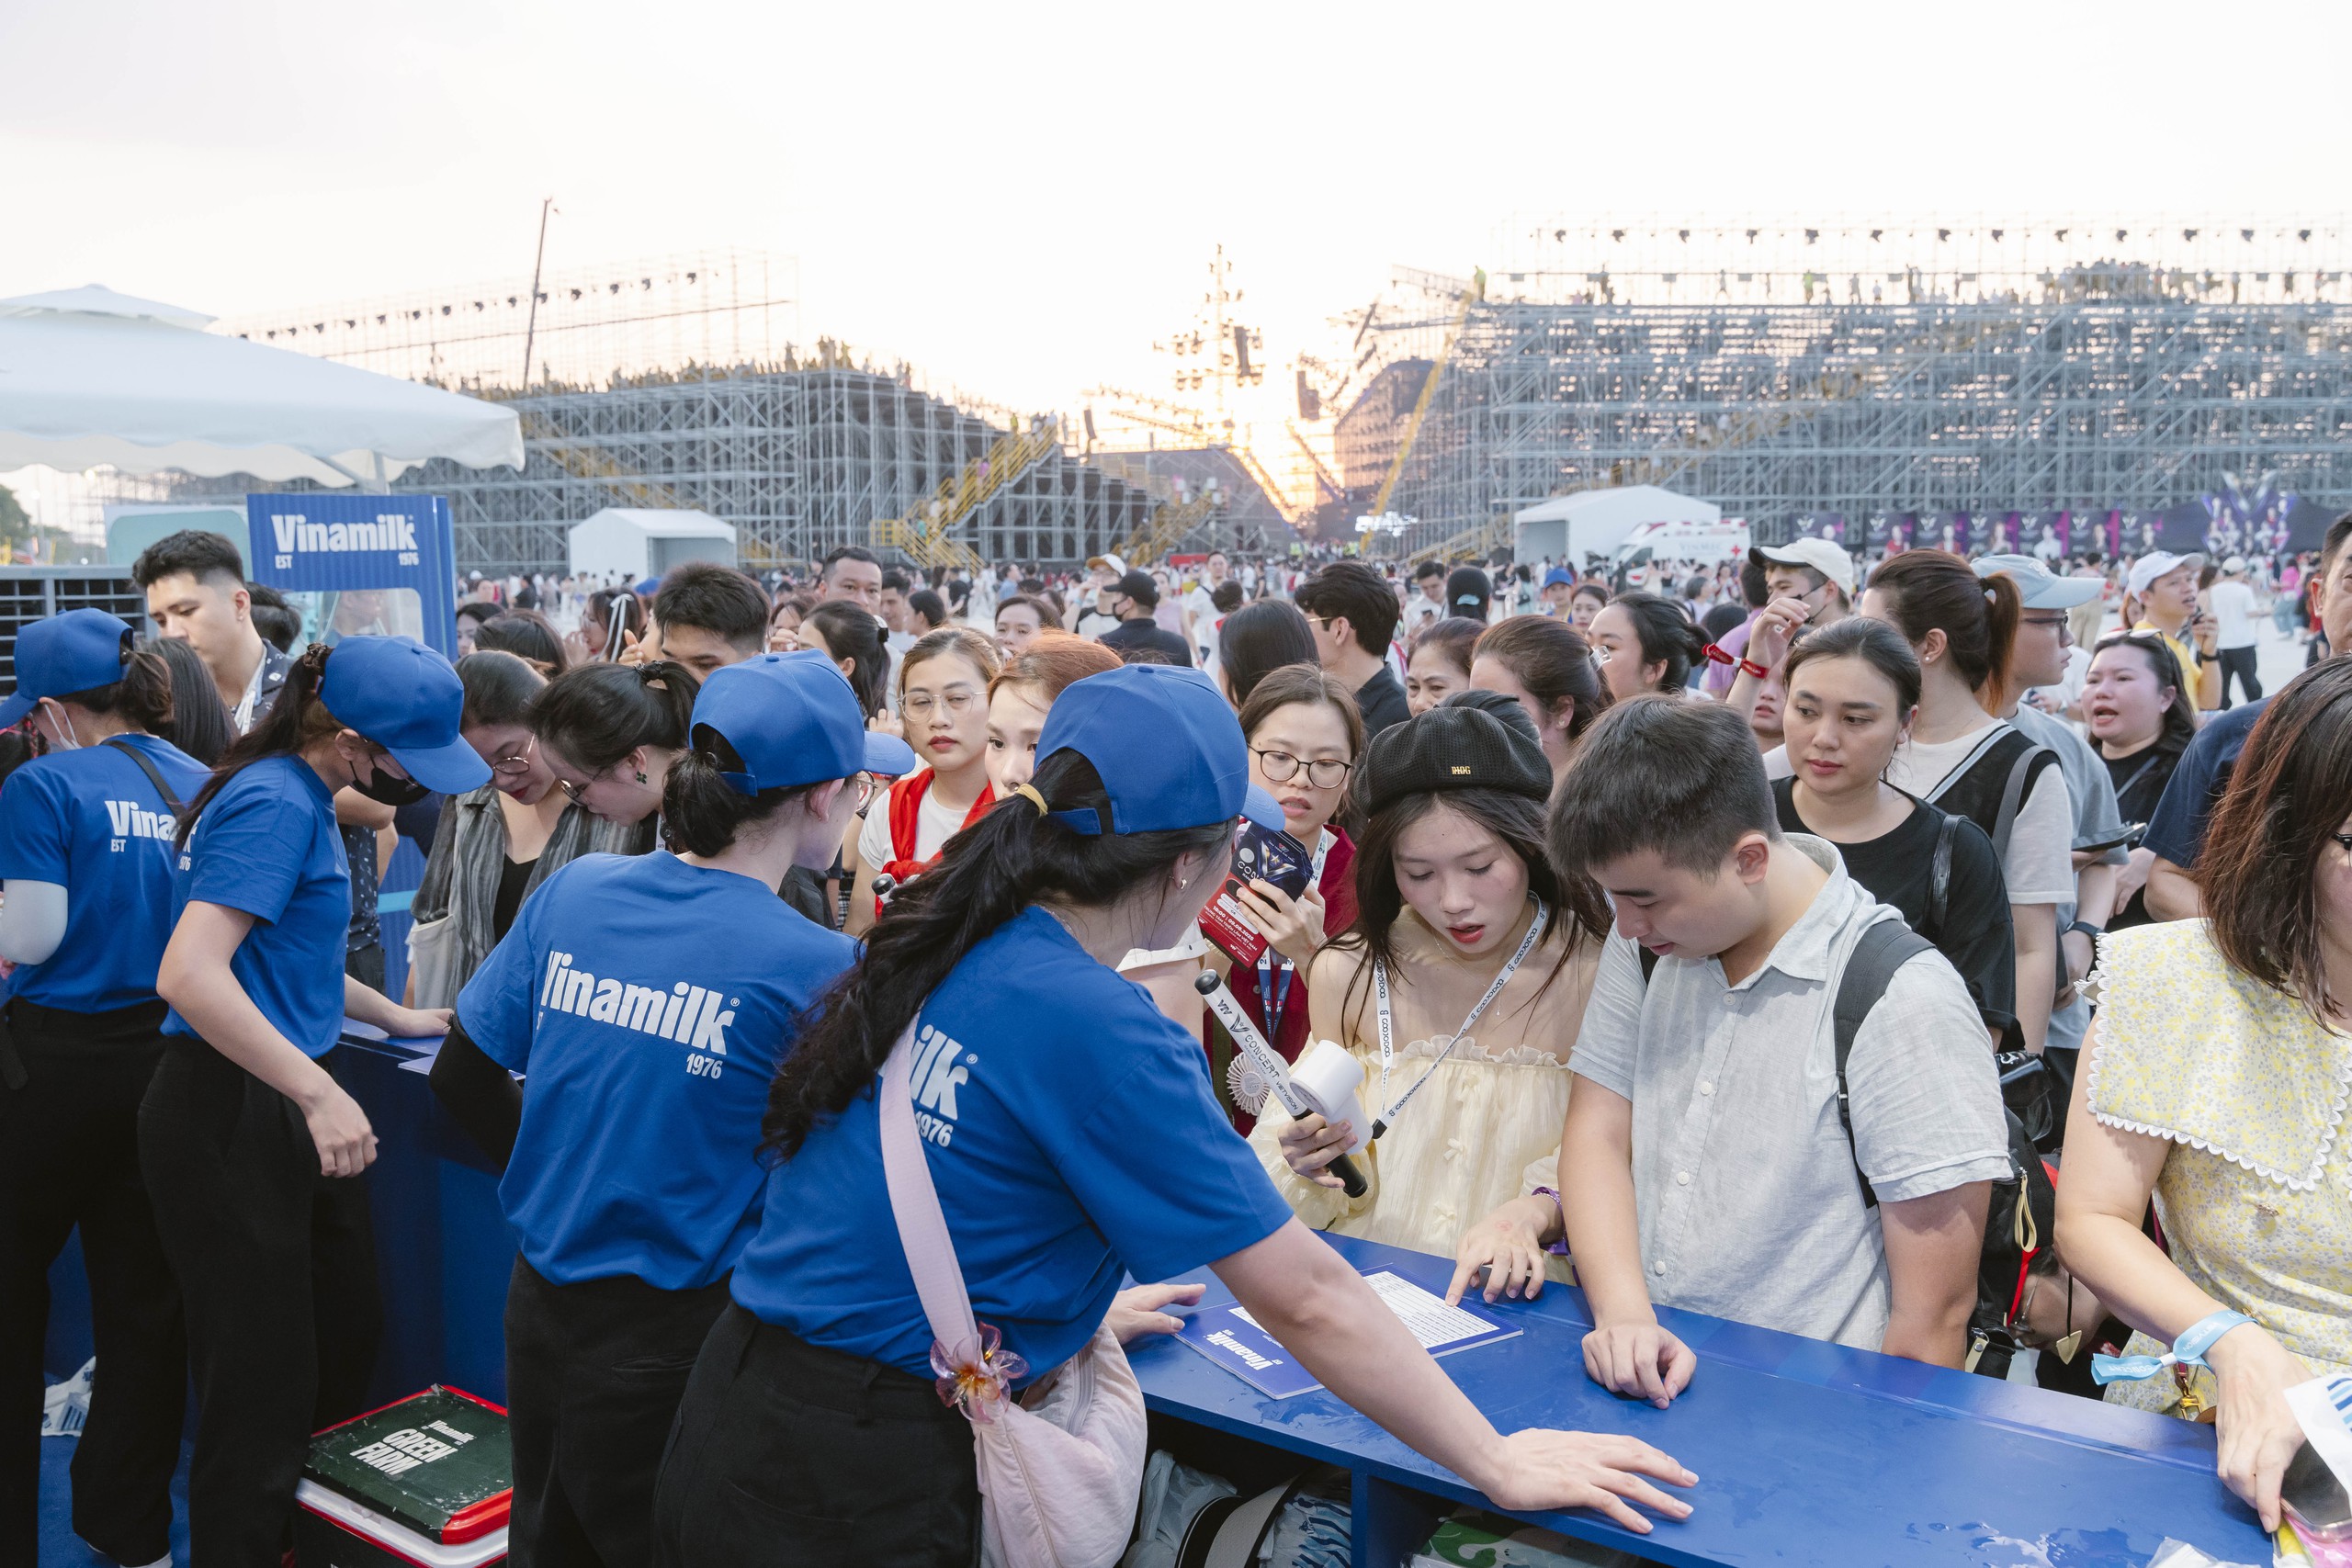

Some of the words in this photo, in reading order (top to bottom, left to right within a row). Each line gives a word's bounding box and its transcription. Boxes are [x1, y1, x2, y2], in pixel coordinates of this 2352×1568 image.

[271, 513, 419, 553] Vinamilk
[275, 554, 293, 570] EST
[398, 552, 419, 566] 1976
[110, 838, 127, 852] EST
[686, 1053, 724, 1079] 1976
[1245, 1034, 1280, 1078] CONCERT
[1204, 1330, 1274, 1371] Vinamilk
[349, 1441, 424, 1475] FARM
[382, 1428, 458, 1463] GREEN
